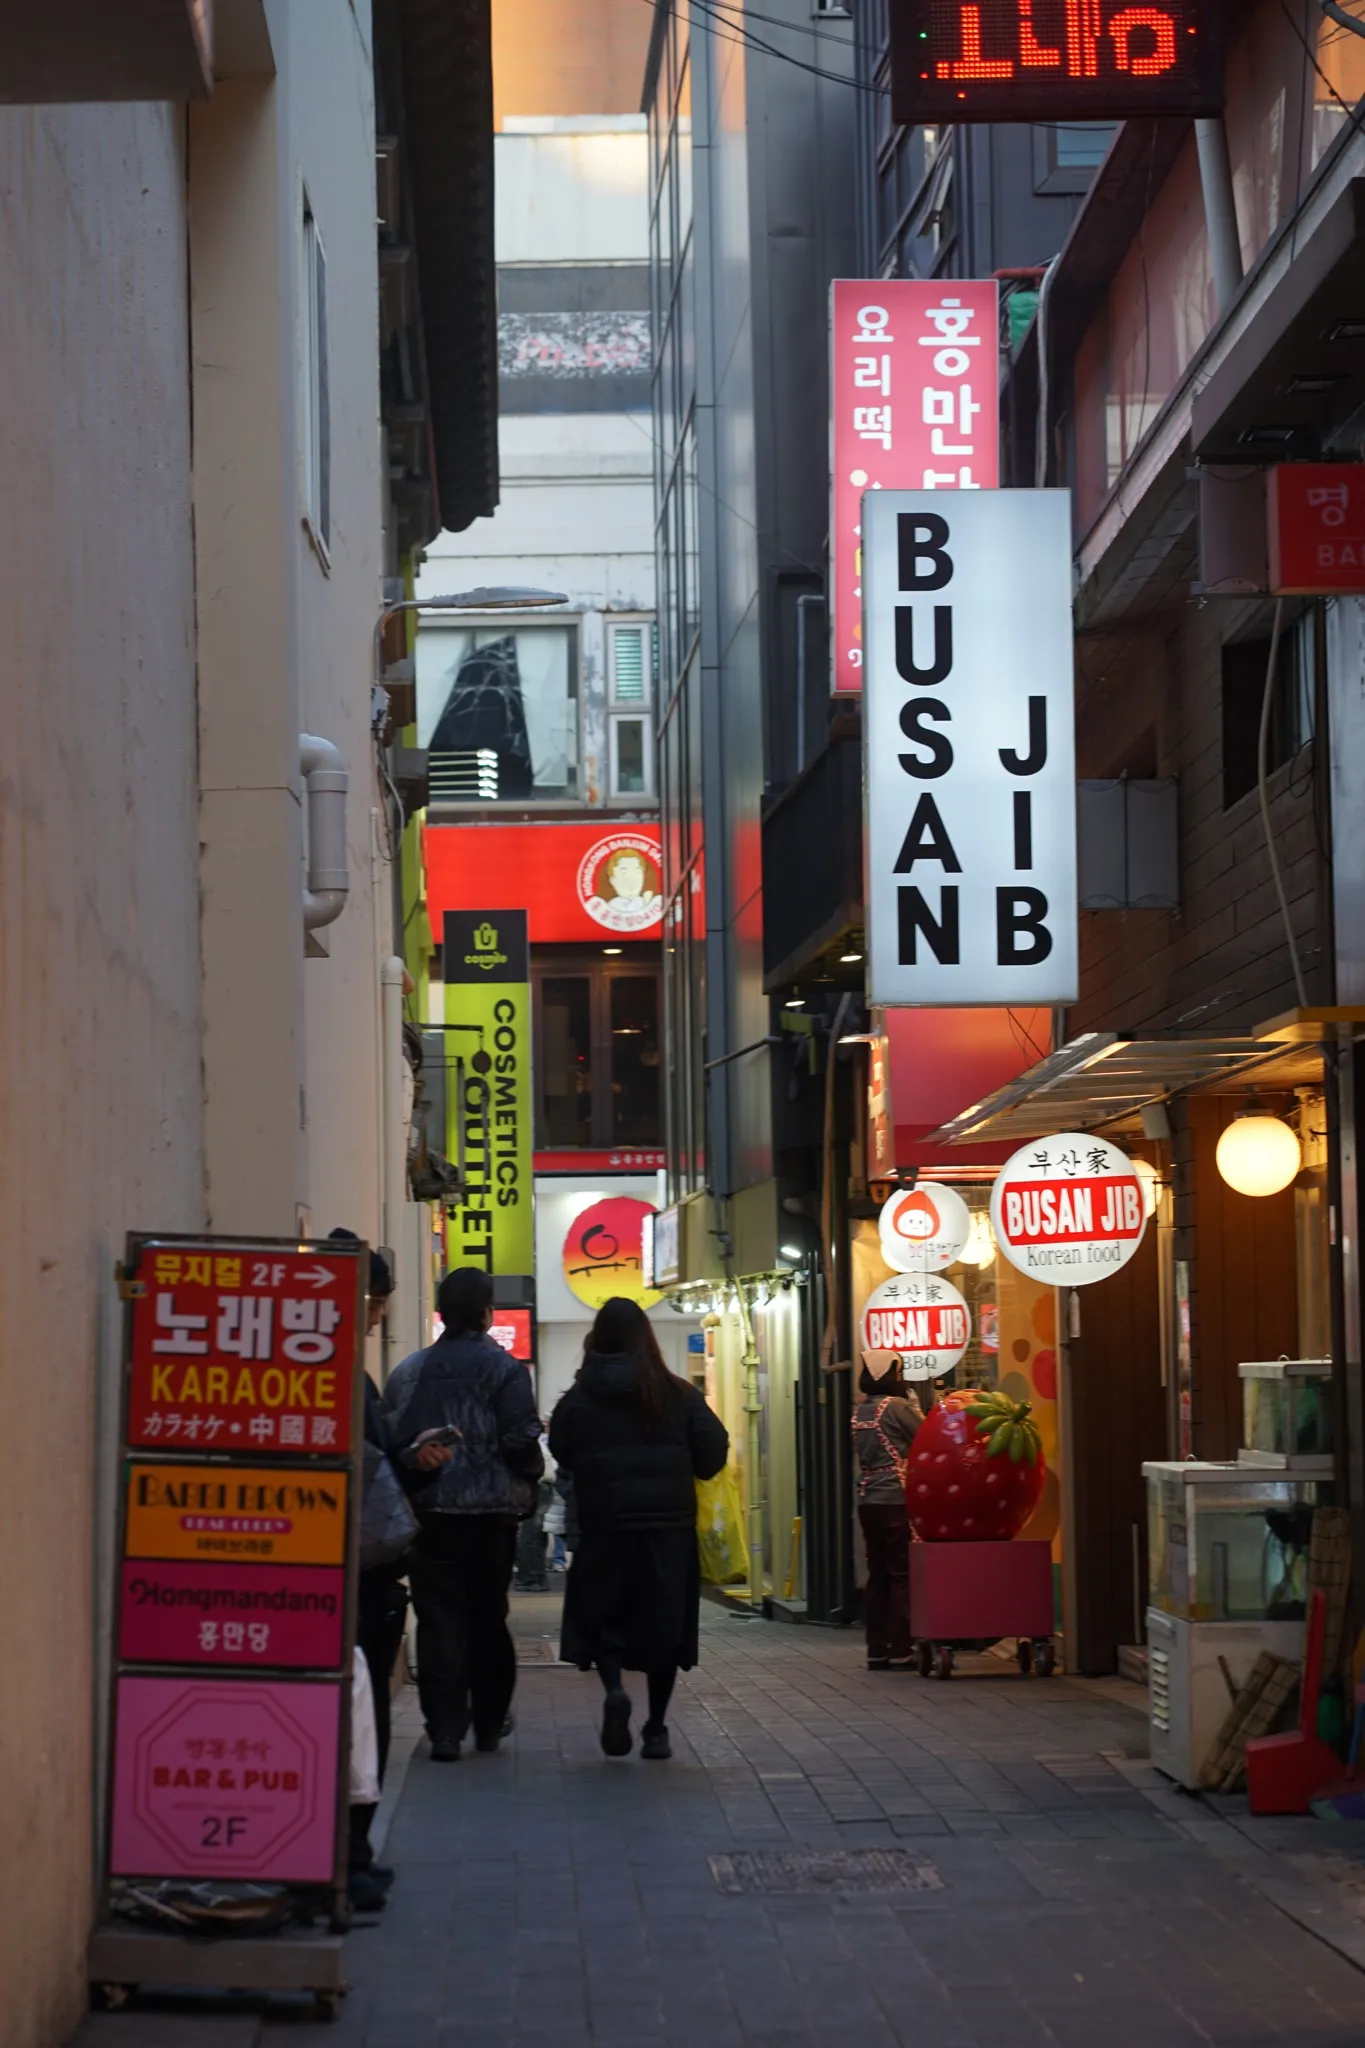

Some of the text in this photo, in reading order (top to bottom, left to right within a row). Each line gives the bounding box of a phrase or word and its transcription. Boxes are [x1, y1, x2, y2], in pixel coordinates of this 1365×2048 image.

[1317, 543, 1365, 568] BA
[893, 512, 963, 966] BUSAN
[996, 695, 1053, 966] JIB
[494, 999, 518, 1208] COSMETICS
[462, 1077, 493, 1274] OUTLET
[1029, 1147, 1111, 1176] 부산家
[1005, 1185, 1141, 1237] BUSAN JIB
[155, 1254, 286, 1288] 뮤지컬 2F
[1027, 1241, 1121, 1267] Korean food
[884, 1283, 944, 1303] 부산家
[152, 1292, 341, 1363] 노래방
[869, 1308, 965, 1349] BUSAN JIB
[903, 1354, 937, 1370] BBQ
[151, 1364, 337, 1409] KARAOKE
[238, 1484, 338, 1514] BROWN
[129, 1579, 338, 1616] Hongmandang
[198, 1621, 270, 1652] 홍만당
[153, 1766, 300, 1793] BAR & PUB
[201, 1816, 249, 1847] 2F
